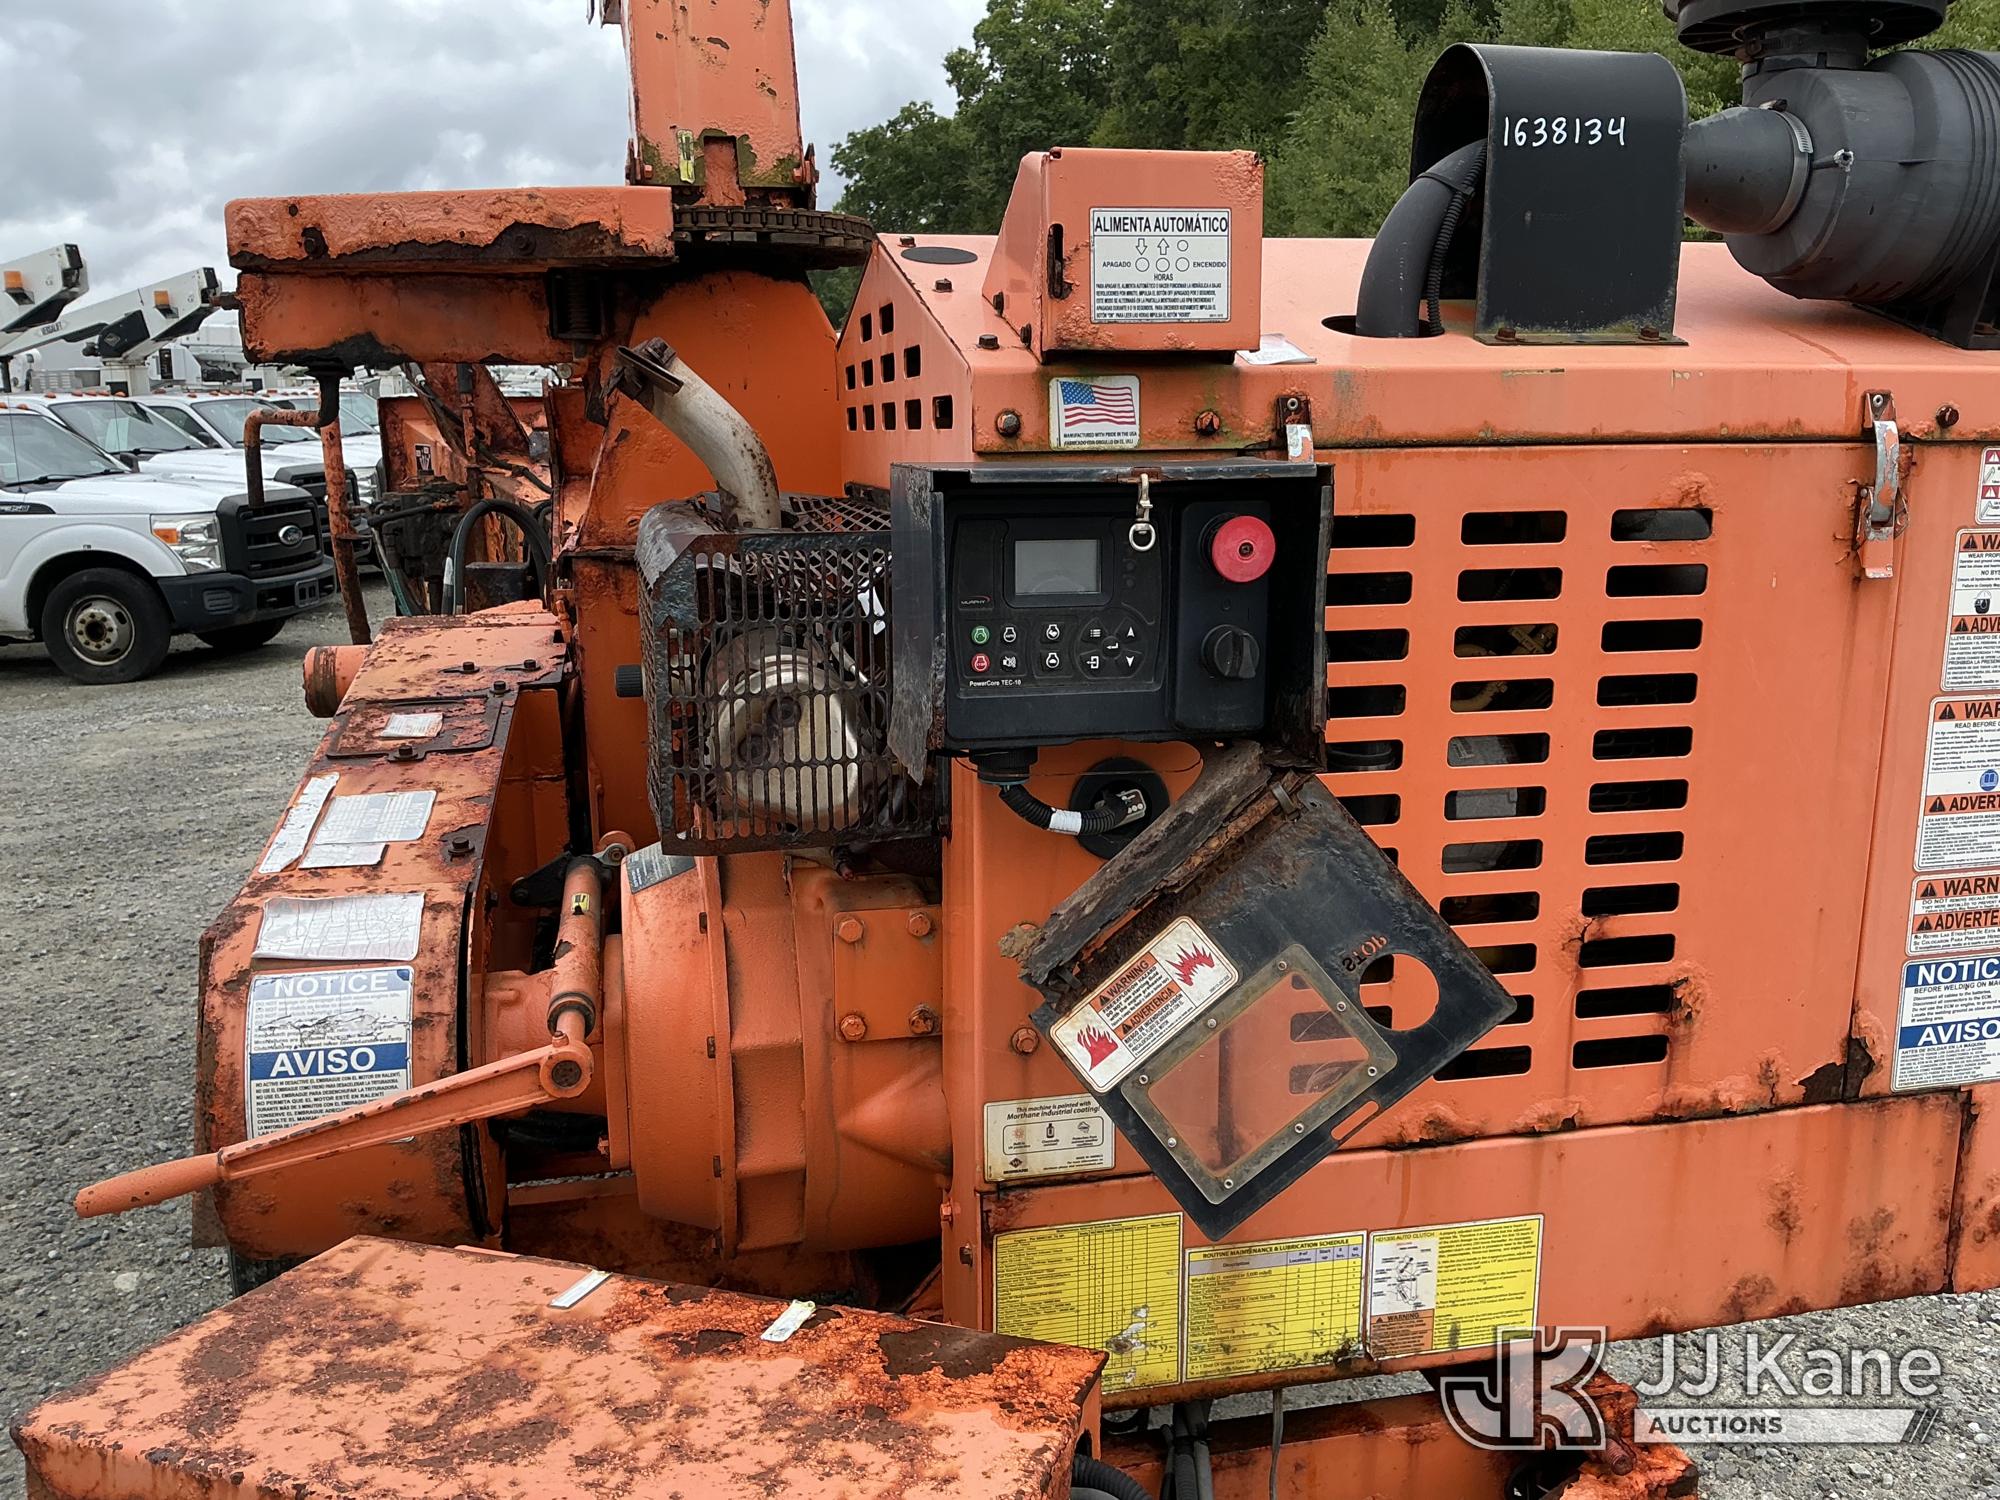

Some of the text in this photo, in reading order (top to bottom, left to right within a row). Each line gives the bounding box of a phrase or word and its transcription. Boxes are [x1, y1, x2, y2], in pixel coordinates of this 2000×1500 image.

[1503, 116, 1625, 147] 1638134
[1095, 212, 1227, 233] ALIMENTA AUTOMÁTICO
[1154, 273, 1173, 281] HORAS
[1107, 960, 1148, 997] WARNING
[1917, 957, 1999, 985] NOTIC
[274, 972, 388, 997] NOTICE
[1105, 971, 1159, 1017] DO NOT use starting fluid
[1914, 985, 1941, 994] BEFORE
[1943, 982, 1974, 991] WELDING
[1109, 975, 1163, 1021] with the engine preheater
[1129, 986, 1174, 1026] ADVERTENCIA
[1917, 1019, 2000, 1046] AVISO
[270, 1047, 376, 1077] AVISO
[1006, 1111, 1040, 1121] Morthane
[1041, 1107, 1072, 1117] industrial
[1028, 1104, 1051, 1112] machine
[1057, 1101, 1078, 1109] painted
[1203, 1251, 1231, 1259] ROUTINE
[1231, 1246, 1272, 1256] MAINTENANCE
[1279, 1241, 1317, 1251] LUBRICATION
[1319, 1238, 1348, 1246] SCHEDULE
[1387, 1312, 1420, 1322] WARNING
